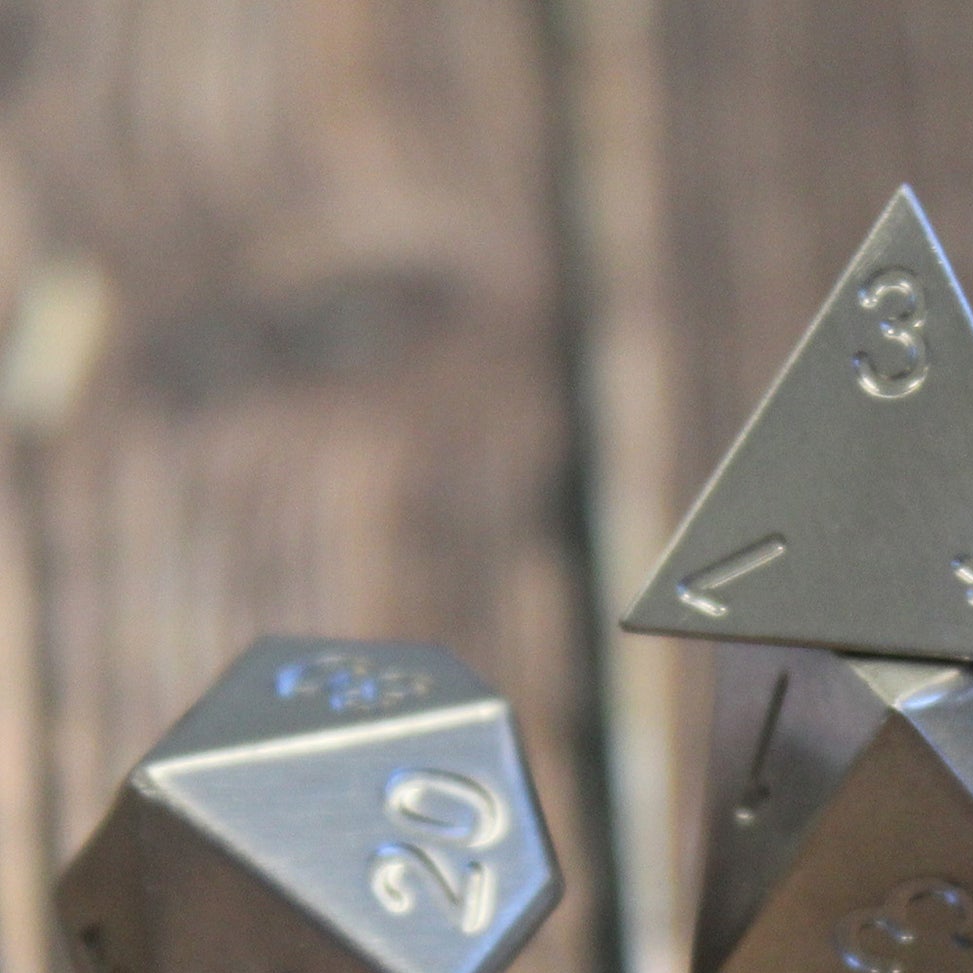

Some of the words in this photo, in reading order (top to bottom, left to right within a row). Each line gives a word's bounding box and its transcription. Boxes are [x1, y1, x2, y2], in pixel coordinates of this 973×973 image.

[852, 266, 928, 399] 3
[676, 534, 787, 617] 1
[370, 768, 510, 936] 20
